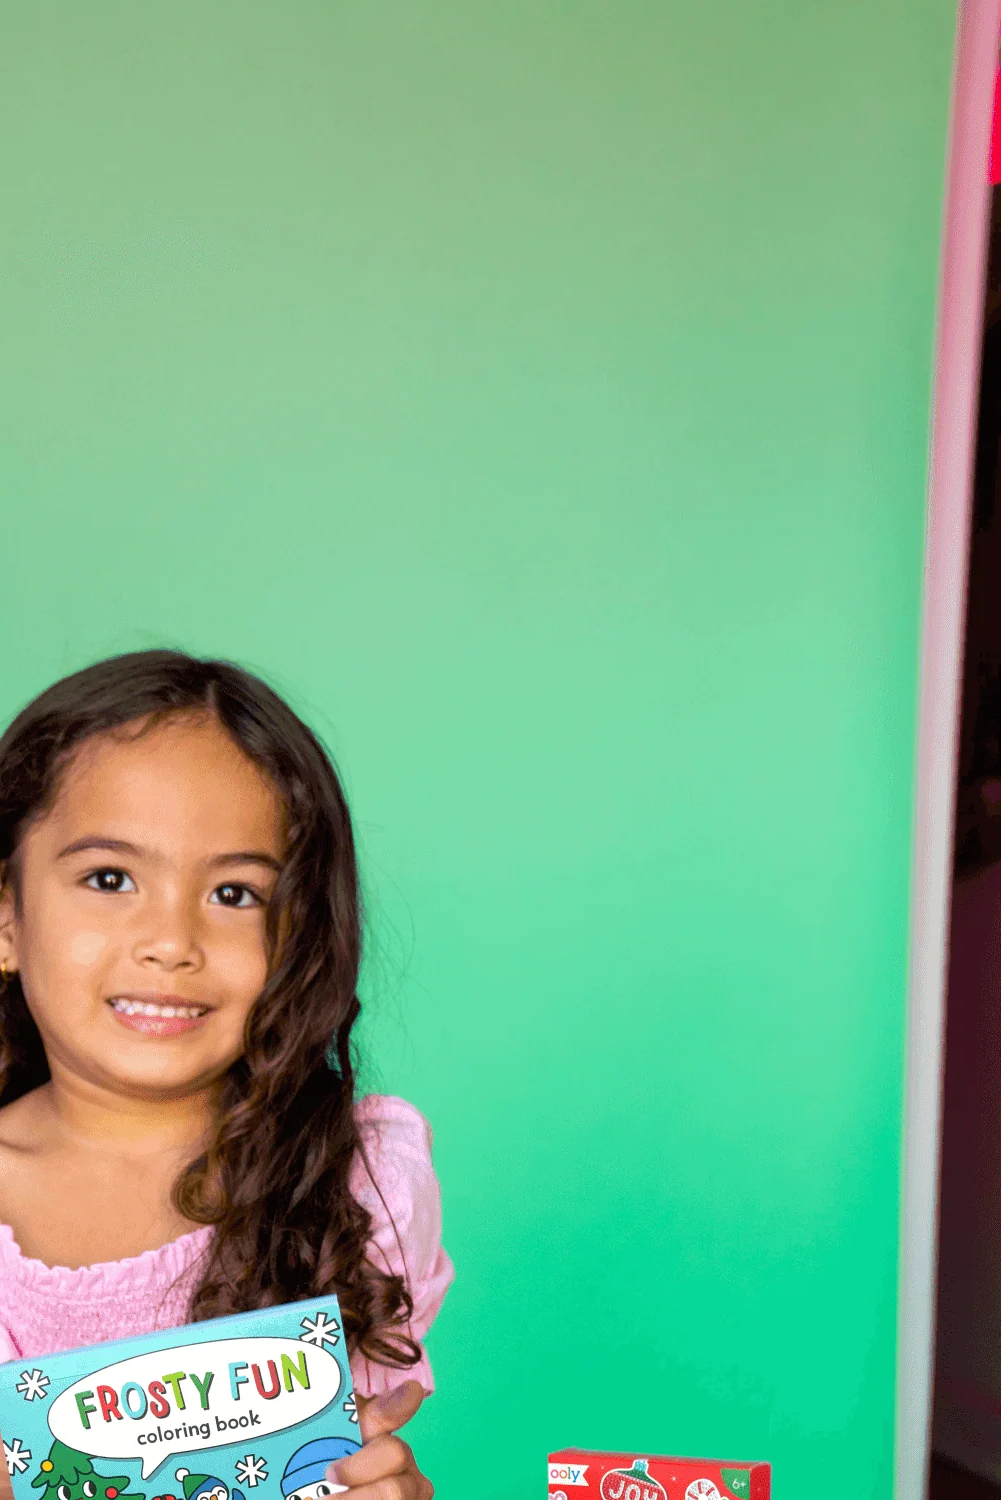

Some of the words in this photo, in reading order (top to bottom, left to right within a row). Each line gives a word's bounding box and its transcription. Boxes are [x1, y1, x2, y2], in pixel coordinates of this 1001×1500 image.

[75, 1371, 215, 1430] FROSTY
[228, 1350, 311, 1401] FUN
[137, 1422, 211, 1446] coloring
[215, 1410, 262, 1432] book
[550, 1466, 580, 1483] ooly
[732, 1478, 746, 1490] 6+
